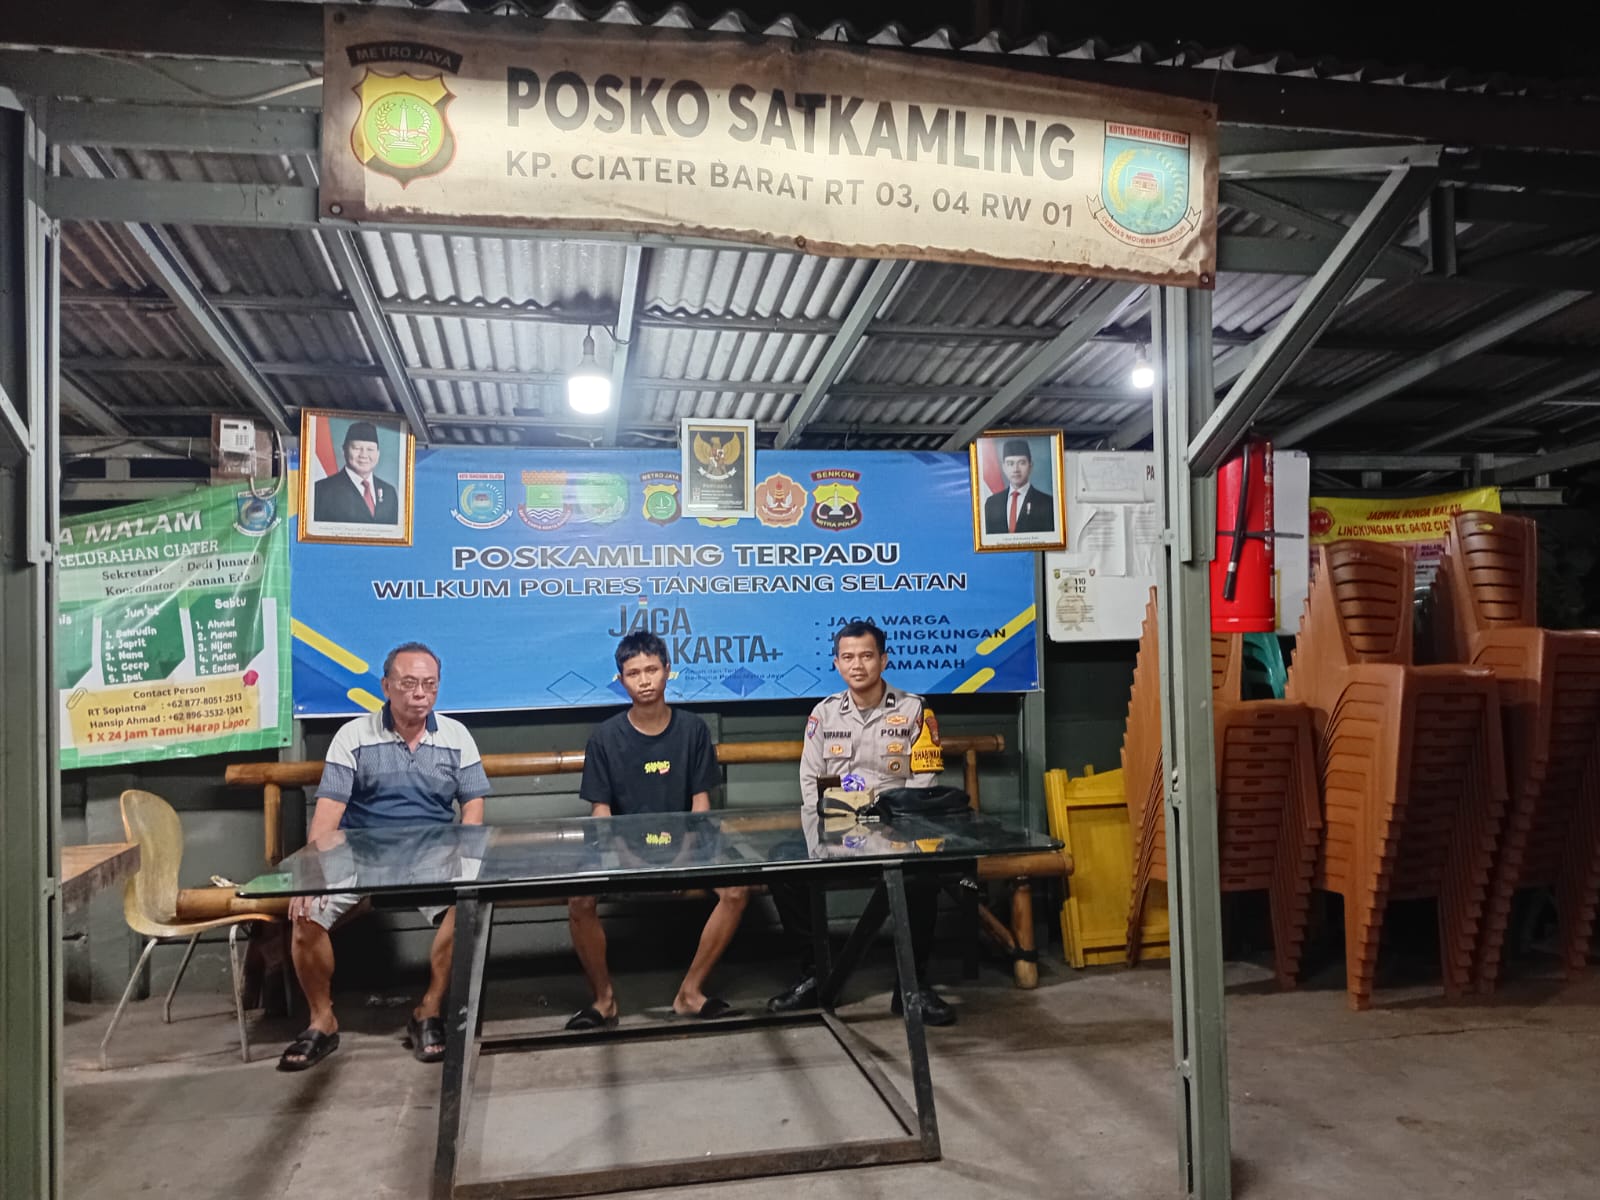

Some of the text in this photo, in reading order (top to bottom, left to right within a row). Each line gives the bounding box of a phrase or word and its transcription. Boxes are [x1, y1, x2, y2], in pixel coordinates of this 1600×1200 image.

[356, 46, 452, 67] METRO JAYA
[506, 66, 1077, 181] POSKO SATKAMLING
[506, 150, 1072, 227] KP. CIATER BARAT RT 03, 04 RW 01
[816, 471, 855, 480] SENKOM
[84, 510, 202, 545] MALAM
[1337, 525, 1394, 537] LINGKUNGAN
[163, 540, 219, 558] CIATER
[453, 543, 901, 570] POSKAMLING TERPADU
[372, 573, 968, 600] WILKUM POLRES TANGERANG SELATAN
[882, 615, 951, 626] WARGA
[885, 628, 1007, 641] LINGKUNGAN
[105, 652, 115, 661] 3.
[133, 686, 206, 699] Contact Person
[87, 707, 101, 716] RT
[90, 719, 124, 729] Hansip
[126, 715, 160, 726] Ahmad
[87, 734, 93, 743] 1
[108, 731, 122, 741] 24
[125, 728, 148, 742] Jam
[151, 726, 184, 737] Tamu
[186, 722, 220, 735] Harap
[222, 717, 250, 732] Lapor
[880, 728, 911, 737] POLRI
